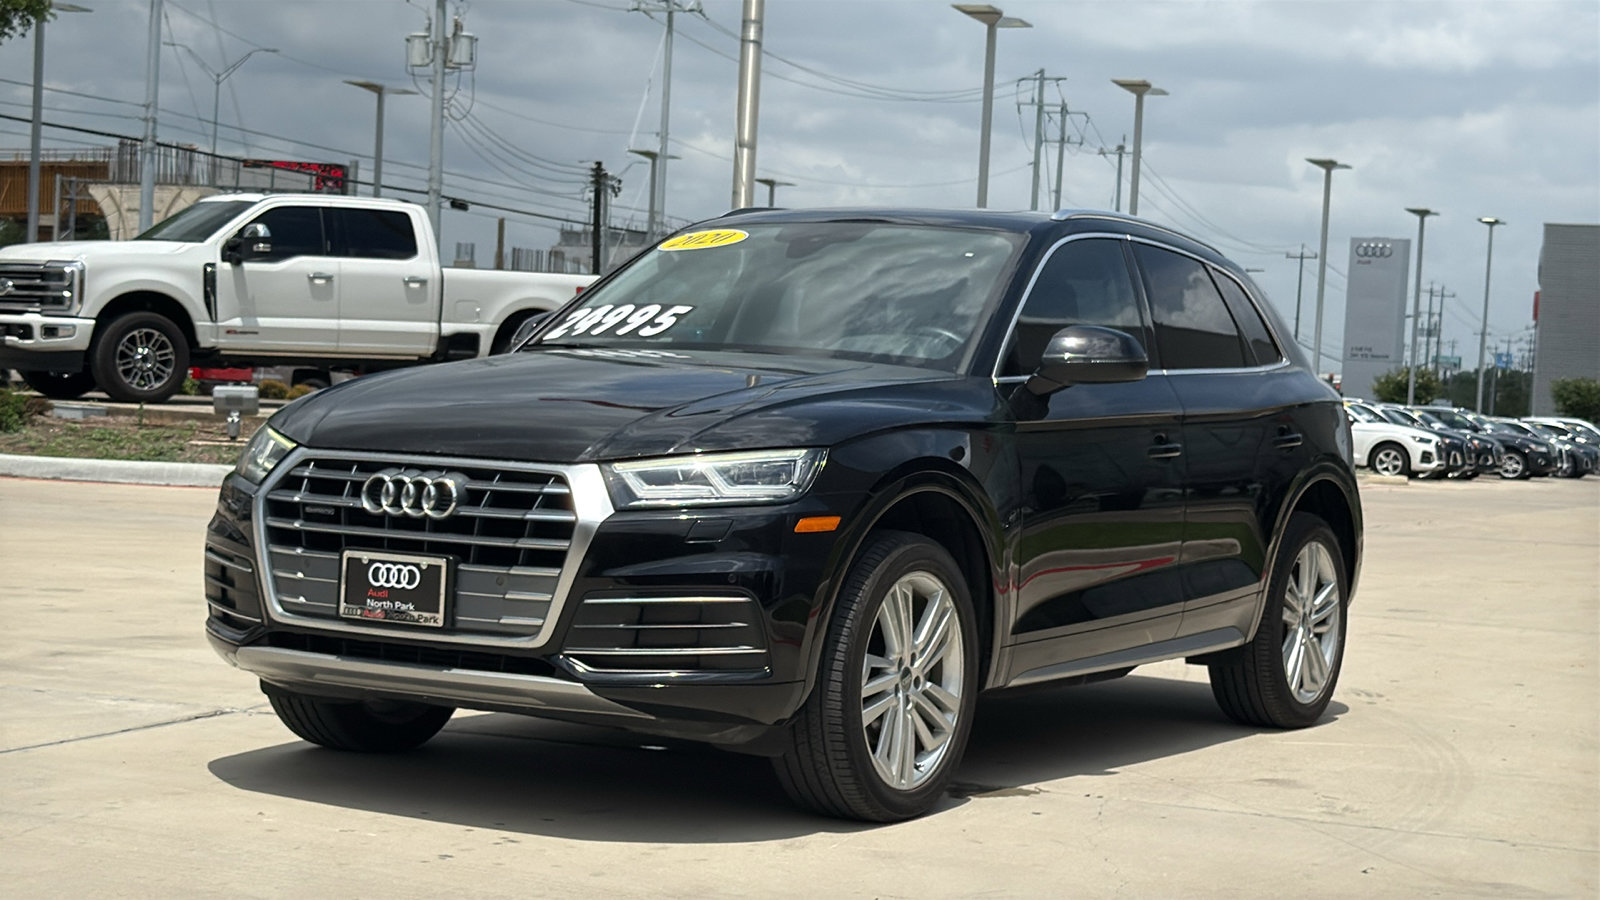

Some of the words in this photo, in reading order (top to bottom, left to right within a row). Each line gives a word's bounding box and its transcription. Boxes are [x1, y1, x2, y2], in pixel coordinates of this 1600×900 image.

[667, 231, 739, 249] 2020
[542, 304, 695, 341] 24995
[367, 588, 389, 599] Audi
[366, 598, 393, 609] North
[394, 601, 416, 612] Park
[417, 613, 440, 625] Park
